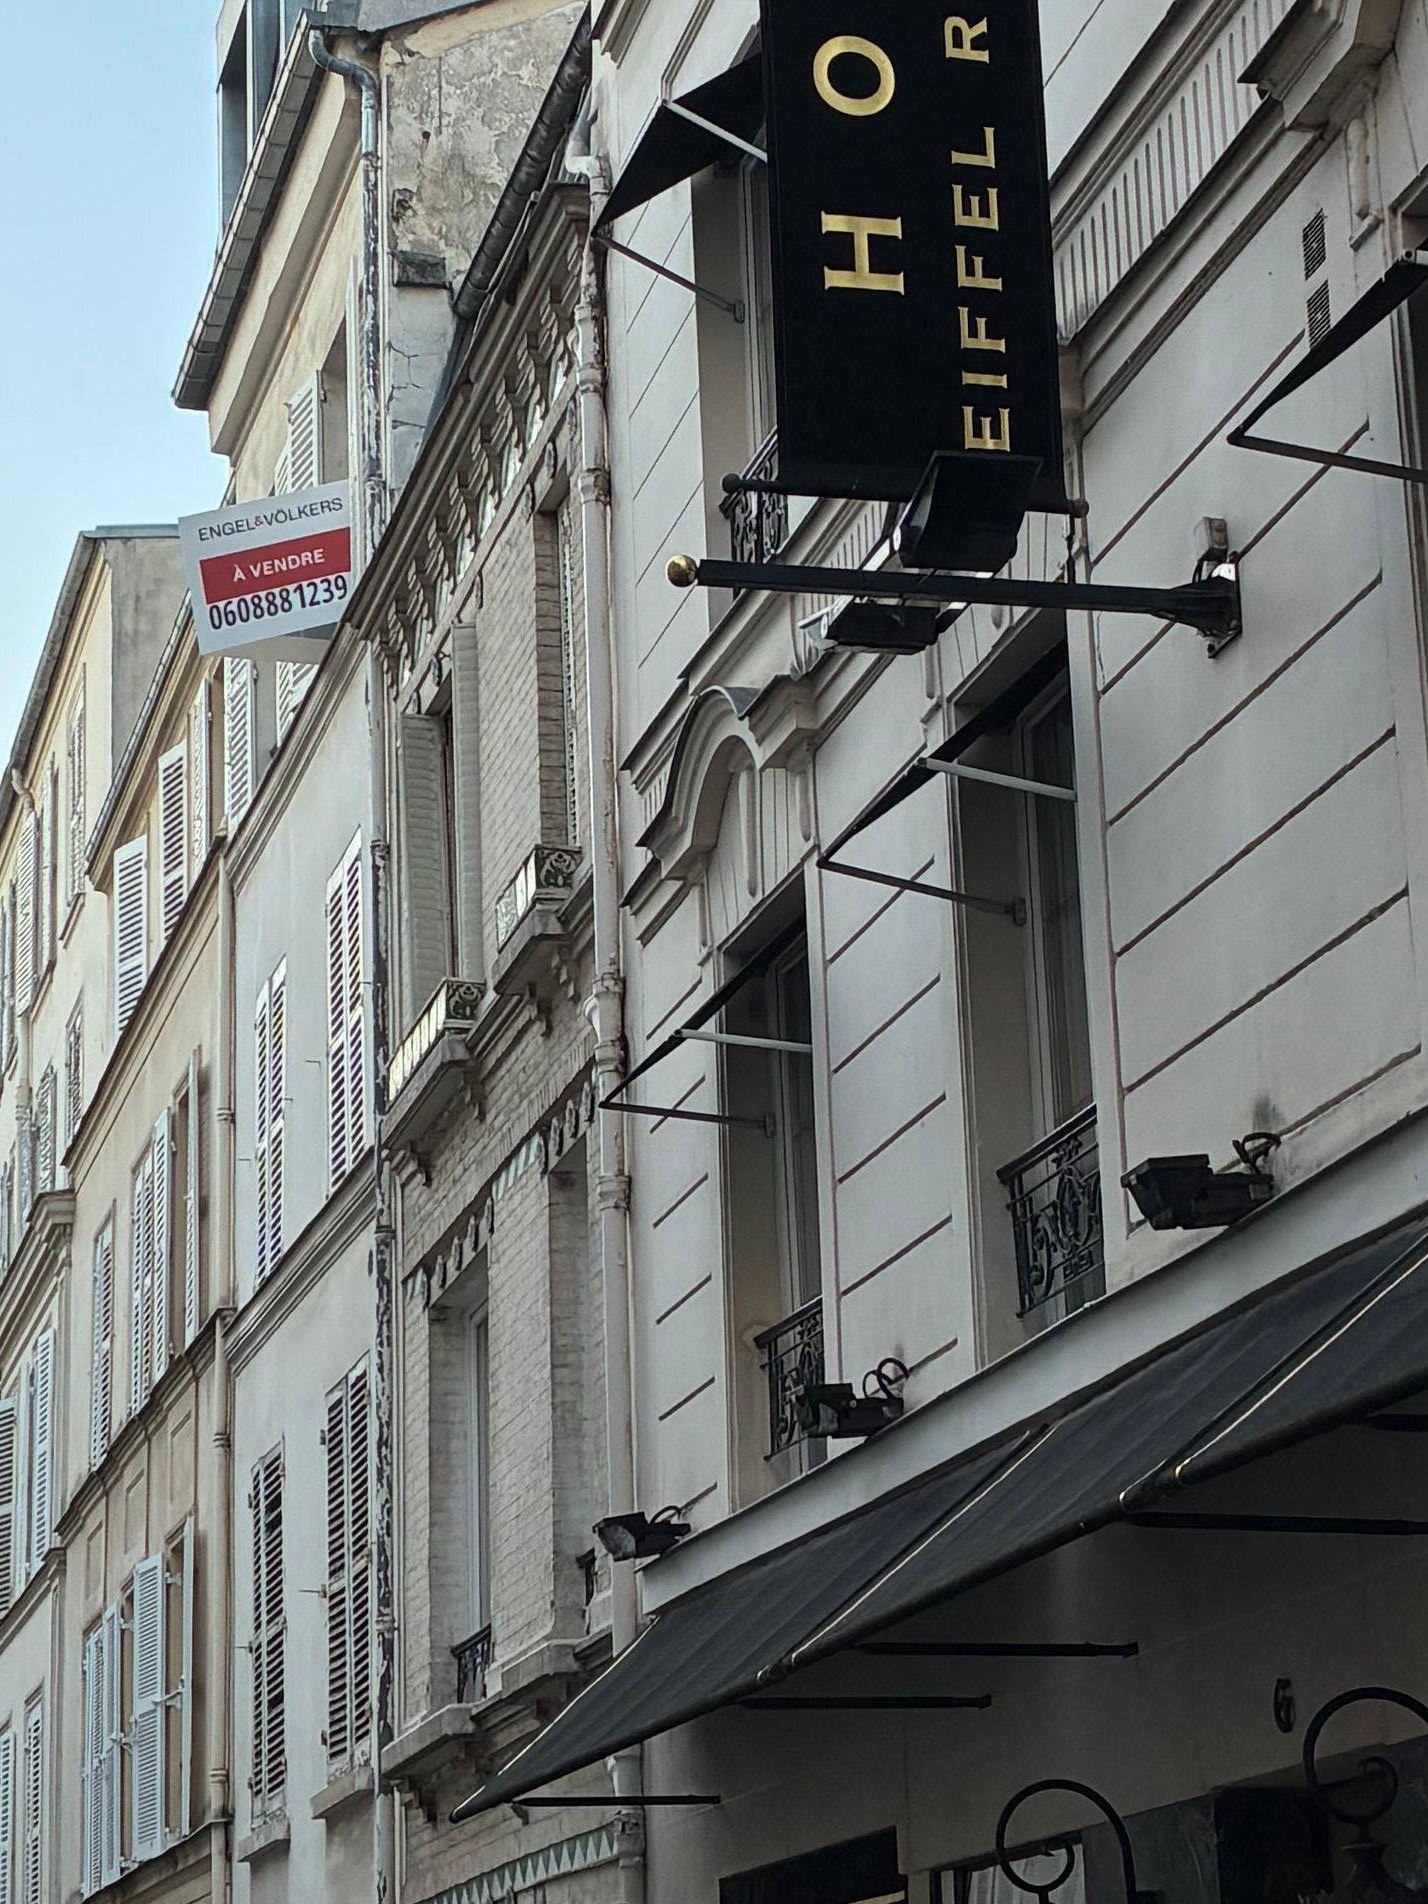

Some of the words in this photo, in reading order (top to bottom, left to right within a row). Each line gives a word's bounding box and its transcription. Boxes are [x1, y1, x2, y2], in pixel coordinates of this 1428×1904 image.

[951, 127, 1010, 452] EIFFEL
[197, 497, 344, 542] ENGEL&VÖLKERS
[232, 563, 247, 583] À
[249, 548, 325, 579] VENDRE
[208, 574, 349, 631] 0608881239
